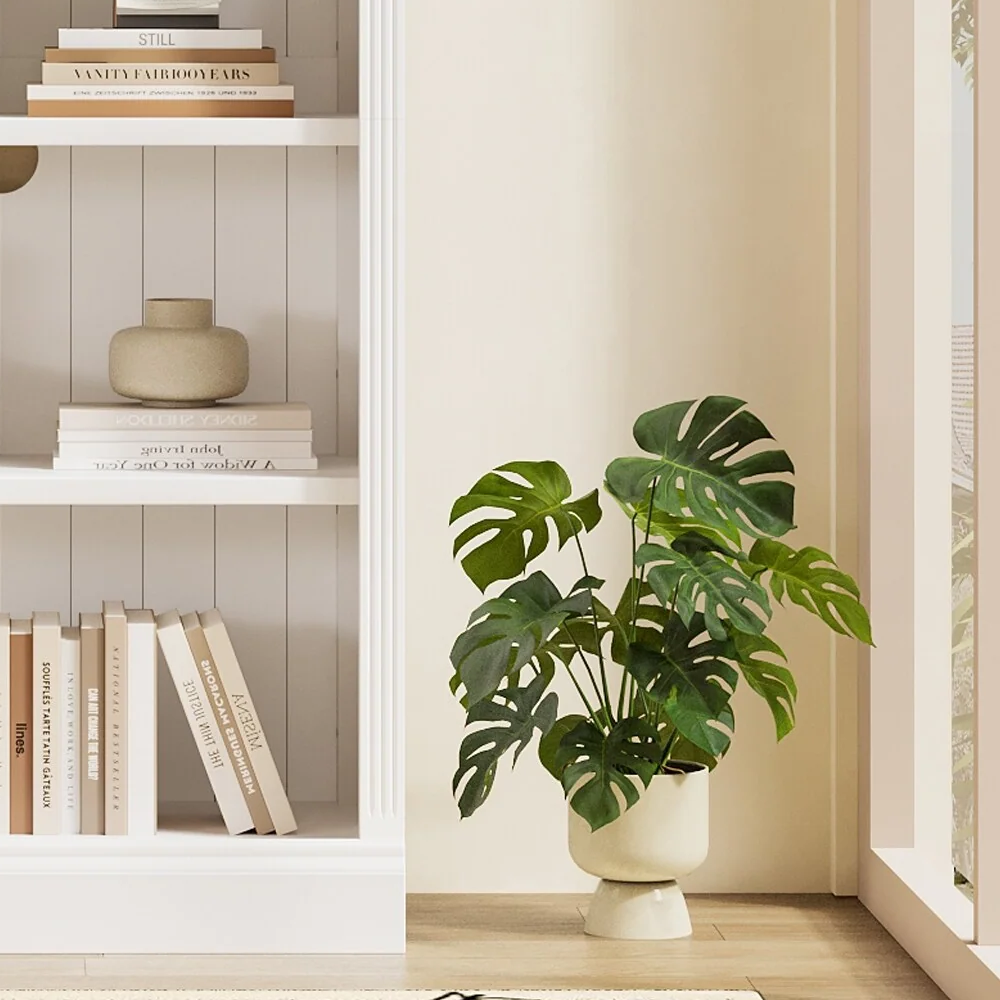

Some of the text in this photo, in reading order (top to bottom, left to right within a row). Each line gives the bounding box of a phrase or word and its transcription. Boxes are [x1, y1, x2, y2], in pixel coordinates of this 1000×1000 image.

[138, 33, 175, 46] STILL
[74, 69, 130, 80] VANITY
[87, 688, 99, 701] CAN
[15, 723, 27, 758] lines.
[42, 662, 53, 809] SOUFFLÉS TARTE TATIN GÂTEAUX
[112, 646, 120, 811] NATIONAL BESTSELLER
